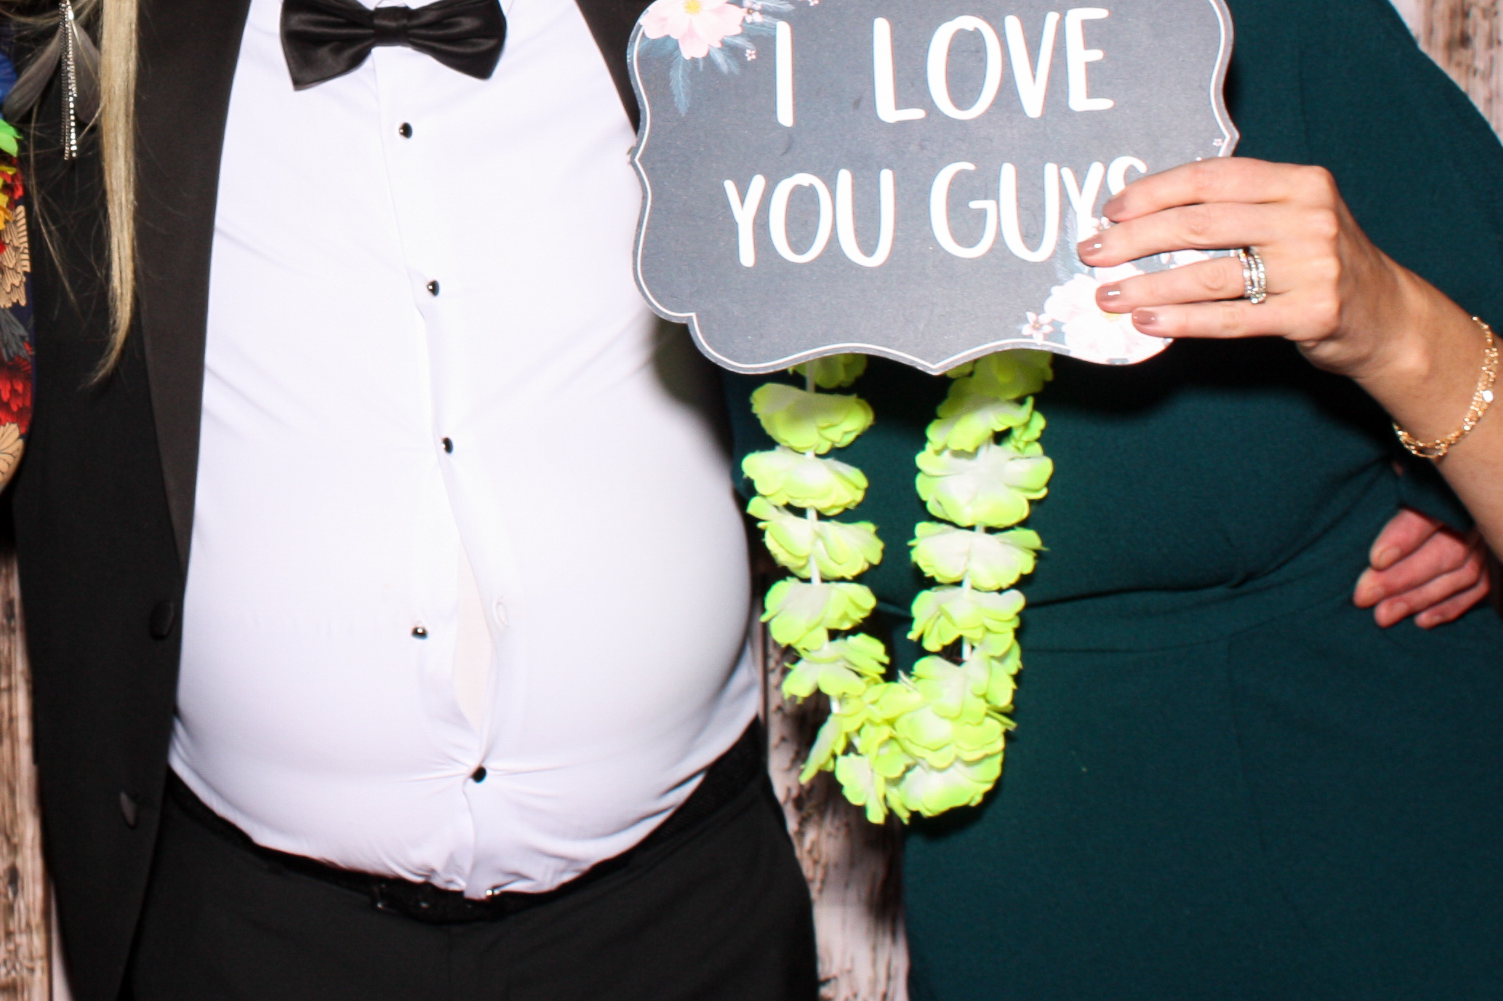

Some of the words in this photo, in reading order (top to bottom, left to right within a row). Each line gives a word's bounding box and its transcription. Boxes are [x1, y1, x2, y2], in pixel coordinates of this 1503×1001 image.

[775, 20, 794, 128] I
[873, 7, 1115, 124] LOVE
[723, 168, 895, 268] YOU
